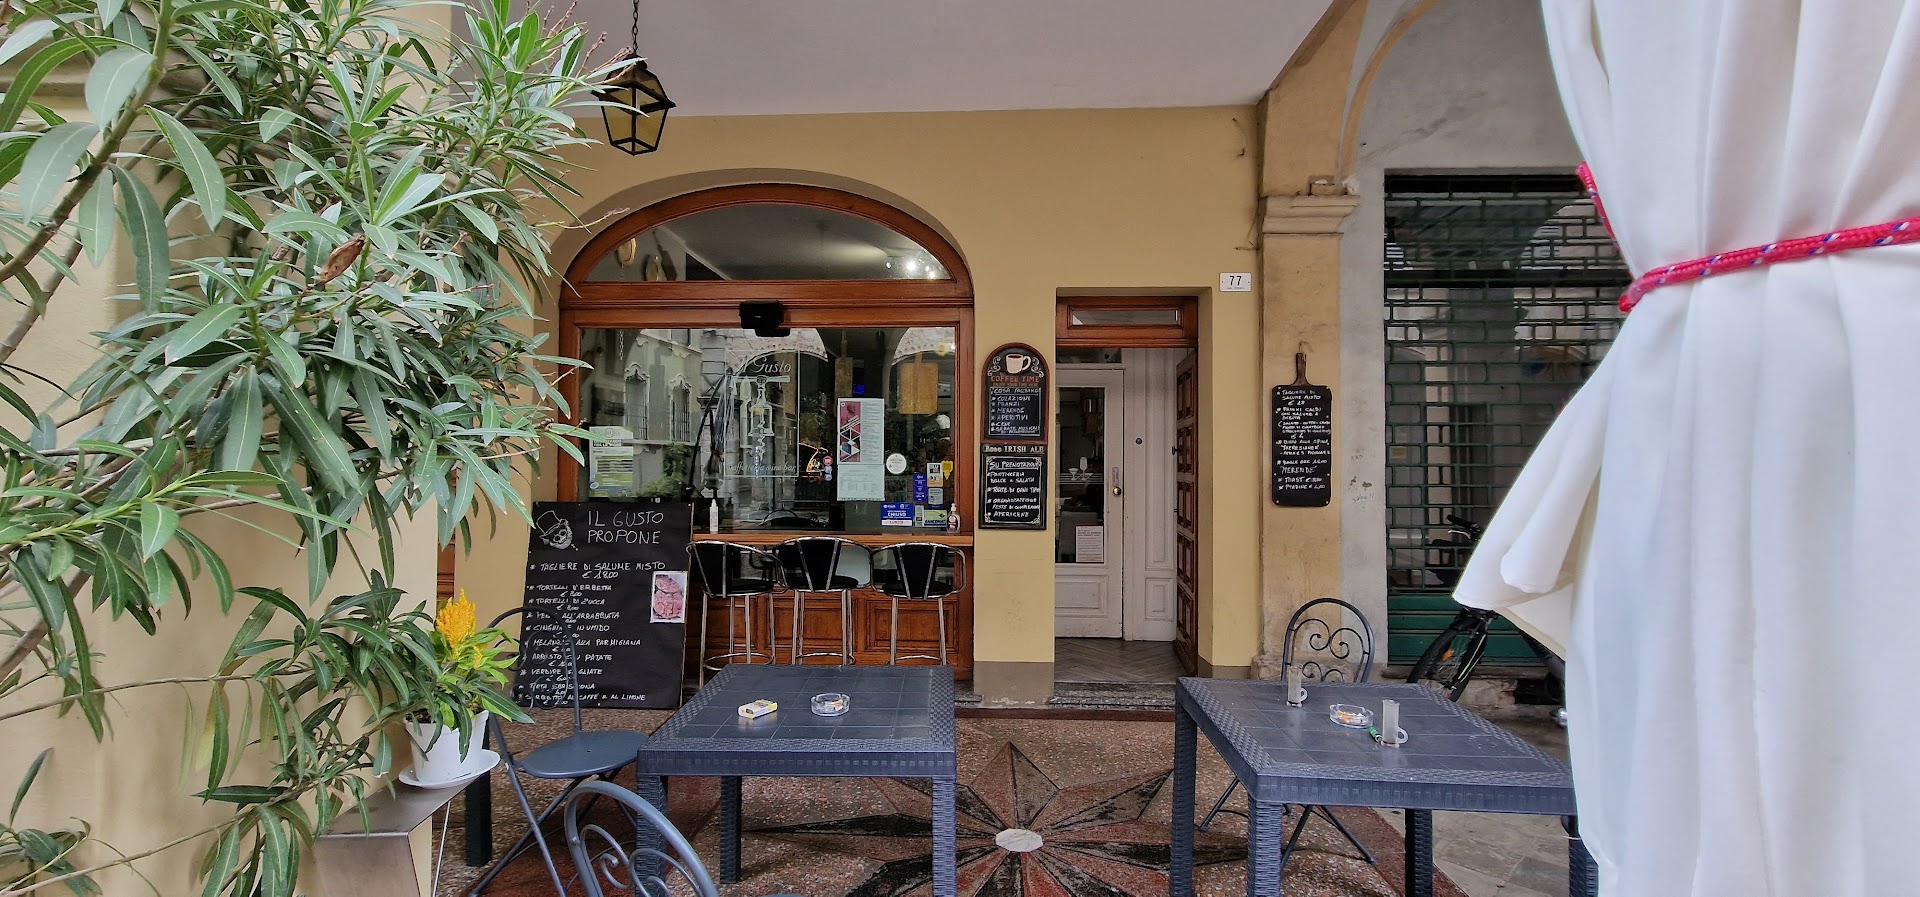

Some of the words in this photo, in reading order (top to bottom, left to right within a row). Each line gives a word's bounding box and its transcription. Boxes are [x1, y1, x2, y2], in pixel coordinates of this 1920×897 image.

[1229, 275, 1242, 286] 77
[750, 356, 792, 373] Gusto
[1022, 375, 1040, 383] TIME
[1004, 445, 1027, 453] IRISH
[1029, 445, 1044, 453] ALE
[784, 460, 797, 471] bar
[989, 461, 1000, 469] SU
[588, 510, 605, 526] IL
[612, 511, 664, 527] GUSTO
[587, 530, 661, 545] PROPONE
[540, 562, 579, 571] TAGLIERE
[583, 563, 591, 571] DI
[594, 562, 631, 571] SALUME
[635, 562, 666, 571] MISTO
[581, 570, 593, 579] €
[535, 597, 569, 605] TORTELLI
[580, 597, 606, 605] ZUCCA
[586, 624, 610, 632] UMIDO
[584, 654, 613, 662] PATATE
